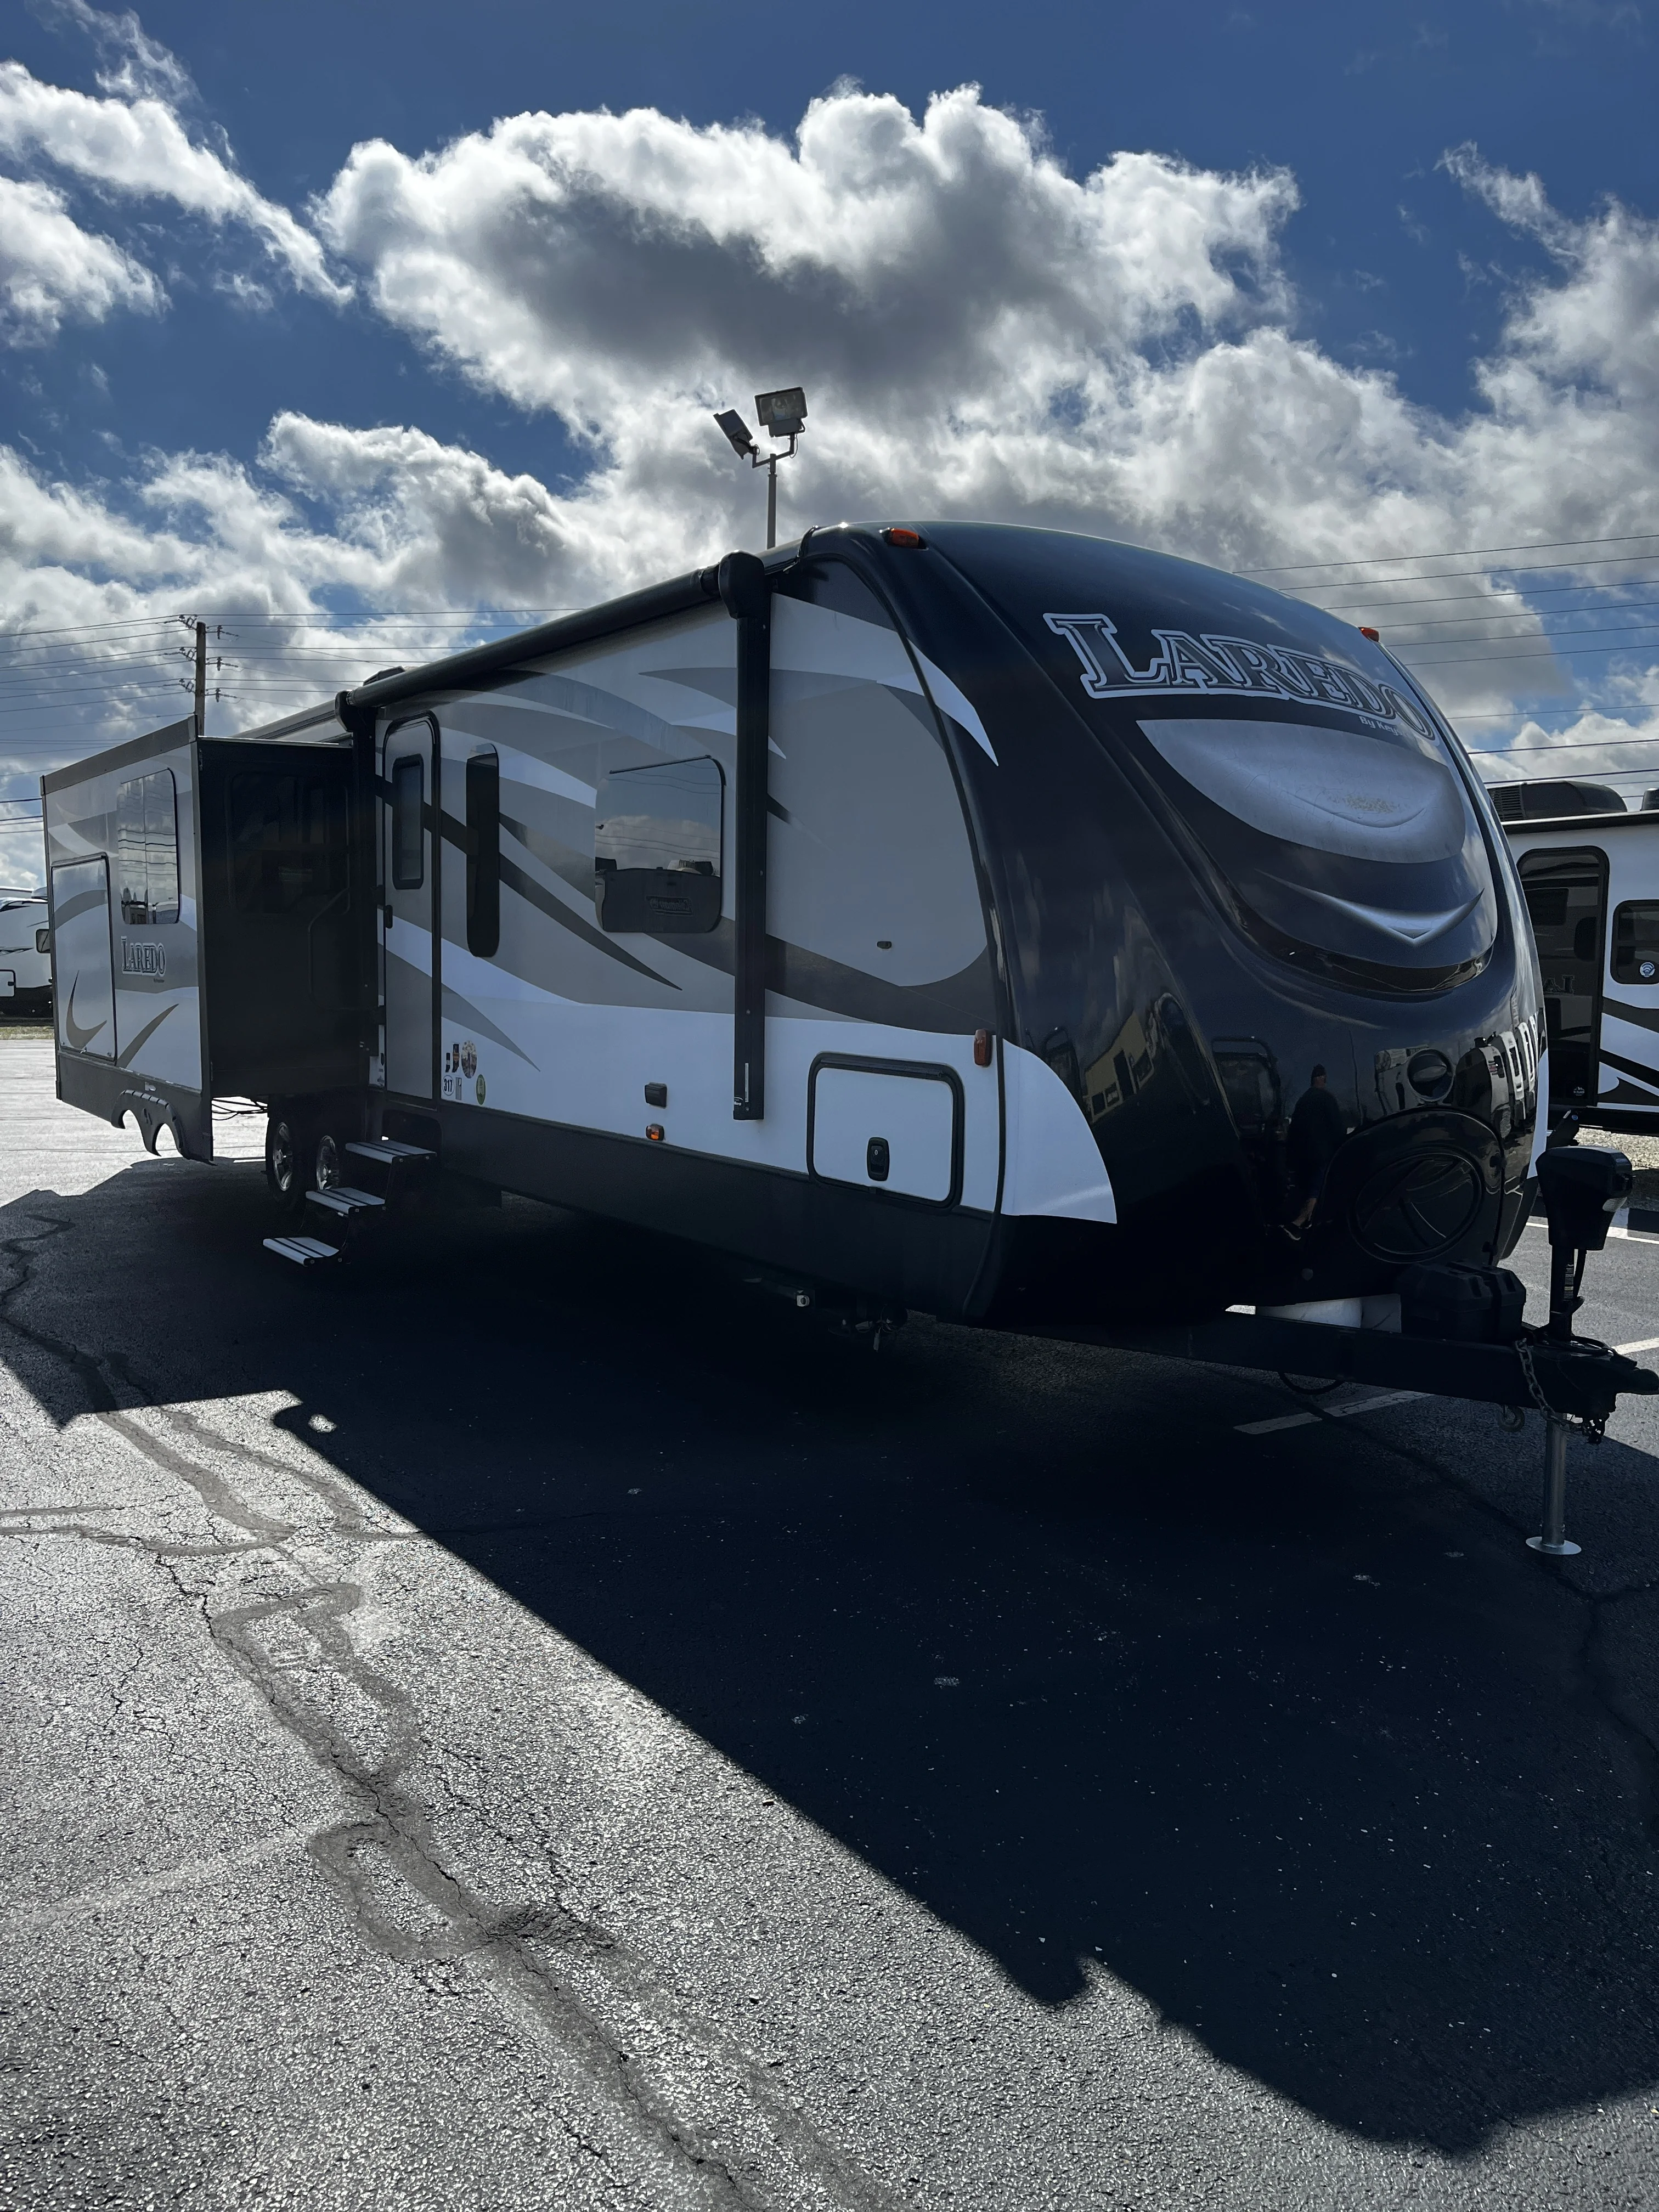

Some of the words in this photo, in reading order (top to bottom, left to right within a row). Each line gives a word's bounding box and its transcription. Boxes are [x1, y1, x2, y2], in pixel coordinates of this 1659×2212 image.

[1043, 613, 1440, 745] LAREDO
[1358, 715, 1376, 729] By
[121, 935, 166, 977] LAREDO
[443, 1078, 453, 1092] 317
